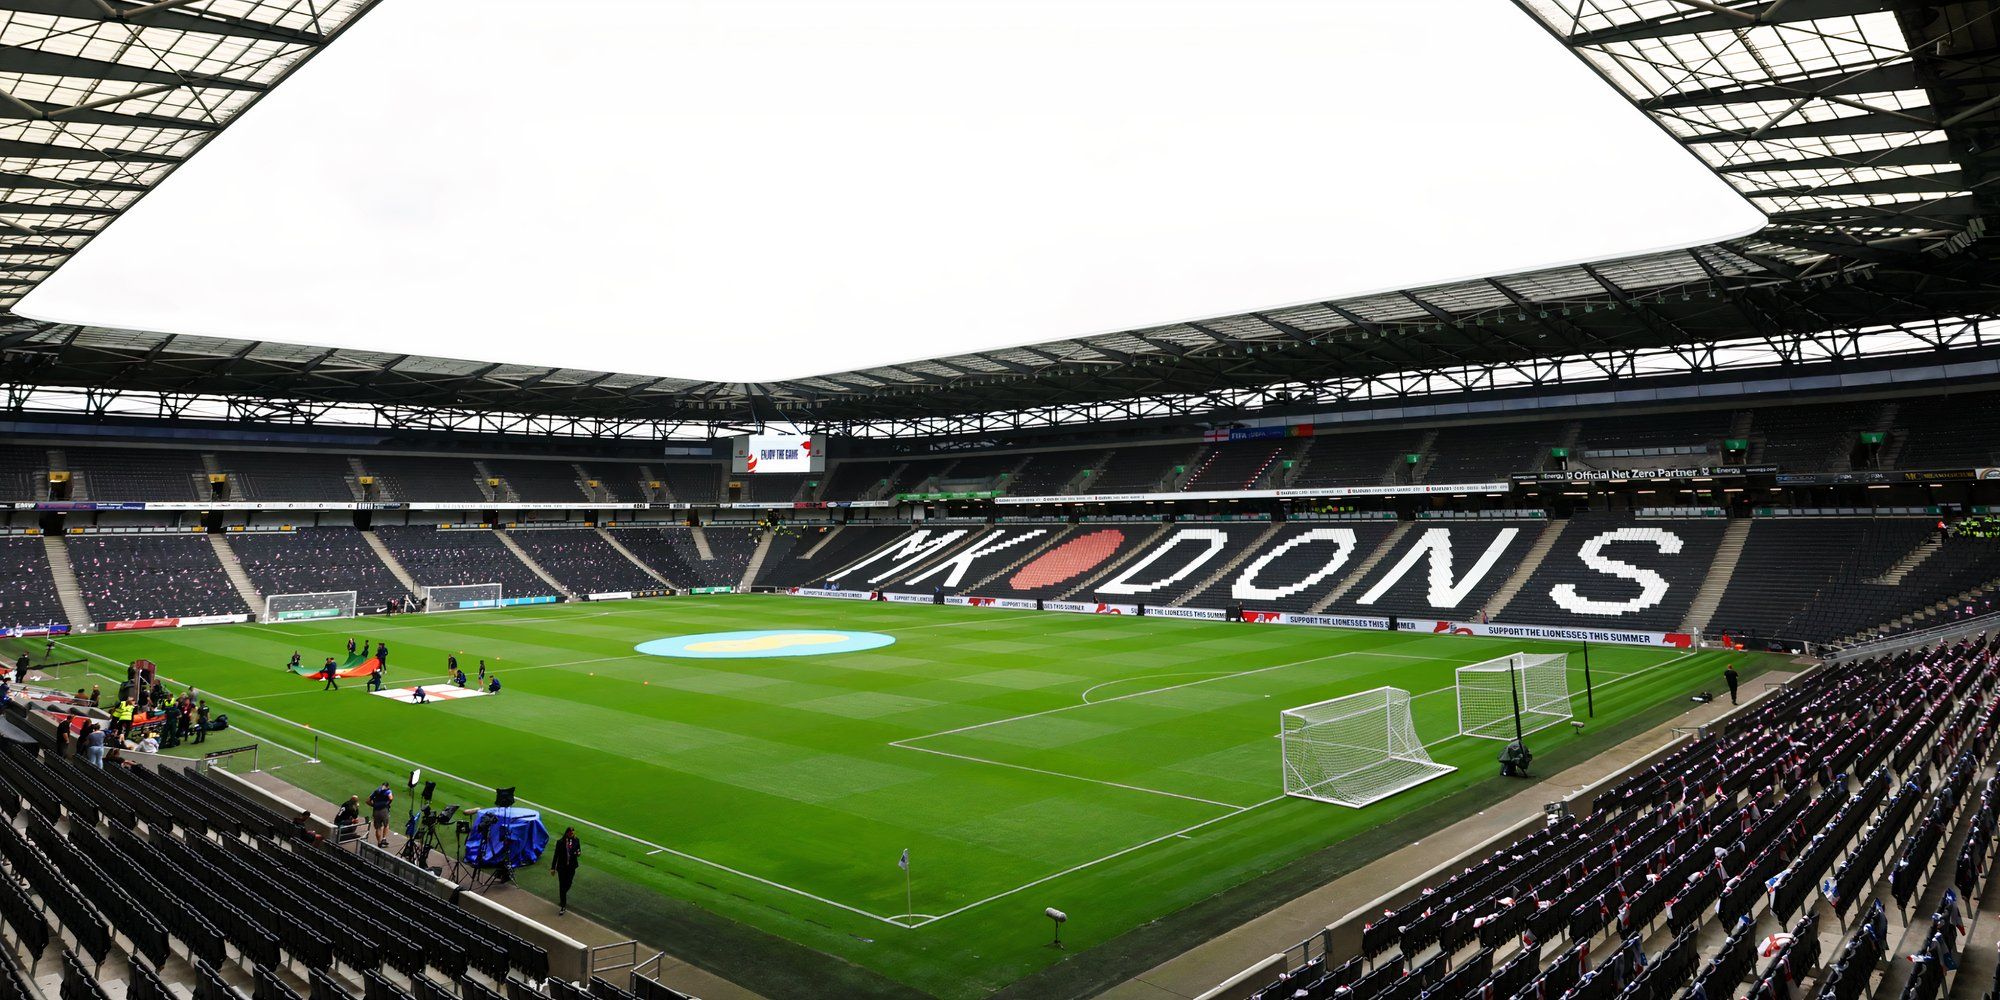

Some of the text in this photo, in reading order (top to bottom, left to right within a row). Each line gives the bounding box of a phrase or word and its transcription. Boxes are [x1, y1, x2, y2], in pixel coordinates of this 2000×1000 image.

[776, 449, 785, 460] THE
[785, 449, 799, 460] GAME
[1574, 469, 1610, 480] Official
[1611, 469, 1630, 480] Net
[1631, 468, 1656, 479] Zero
[827, 529, 1048, 588] MK
[1094, 527, 1685, 616] DONS
[1164, 609, 1193, 617] LIONESSES
[1290, 615, 1318, 624] SUPPORT
[1319, 617, 1332, 625] THE
[1332, 618, 1368, 627] LIONESSES
[1368, 620, 1384, 628] THIS
[1488, 626, 1651, 643] SUPPORT THE LIONESSES THIS SUMMER
